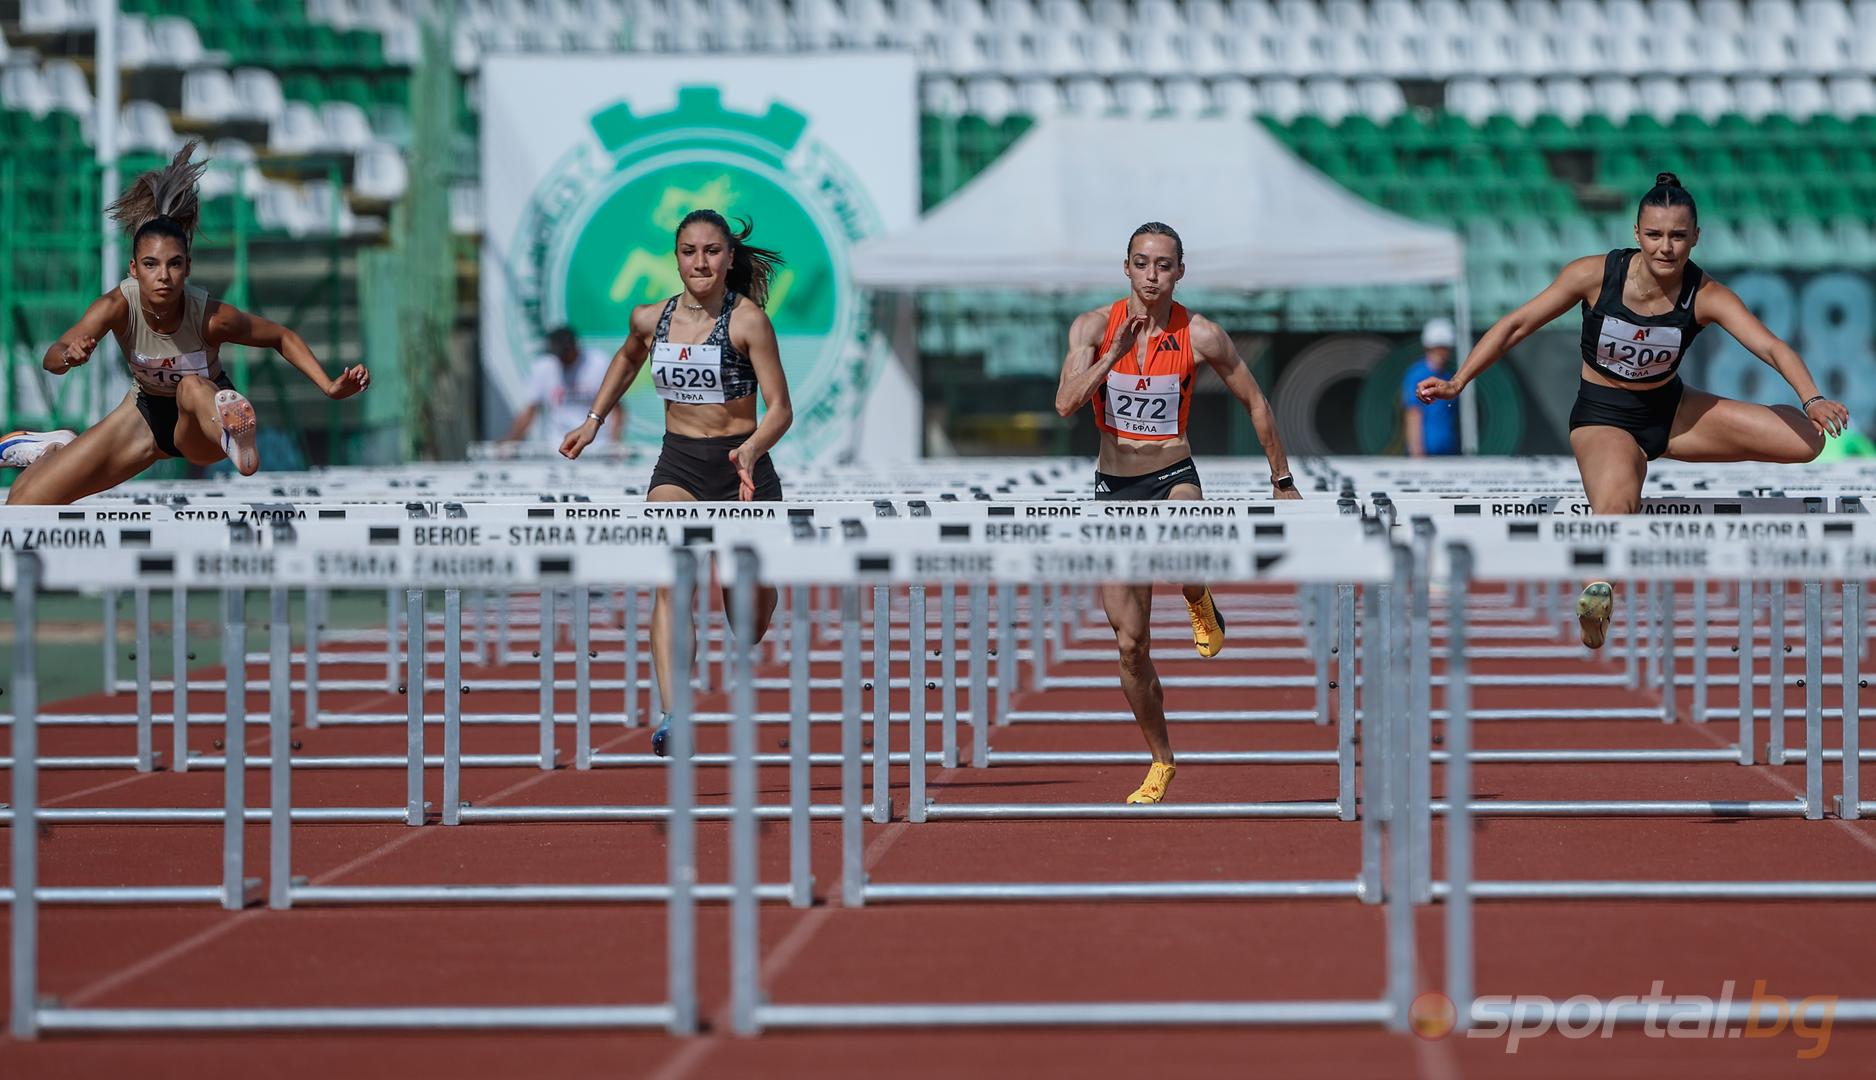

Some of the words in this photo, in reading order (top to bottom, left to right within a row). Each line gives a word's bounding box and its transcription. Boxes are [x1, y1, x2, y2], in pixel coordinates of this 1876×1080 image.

[1632, 327, 1651, 341] A1
[679, 346, 692, 360] A1
[1604, 341, 1672, 367] 1200
[160, 356, 176, 368] A1
[656, 366, 717, 388] 1529
[1135, 377, 1151, 391] A1
[1116, 394, 1167, 420] 272
[1132, 424, 1157, 433] БФЛА
[1639, 504, 1703, 516] AGORA
[23, 529, 106, 548] ZAGORA
[414, 527, 480, 545] BEROE
[509, 527, 576, 545] STARA
[586, 527, 669, 545] ZAGORA
[986, 524, 1053, 543] BEROE
[1080, 524, 1147, 543] STARA
[1157, 524, 1239, 543] ZAGORA
